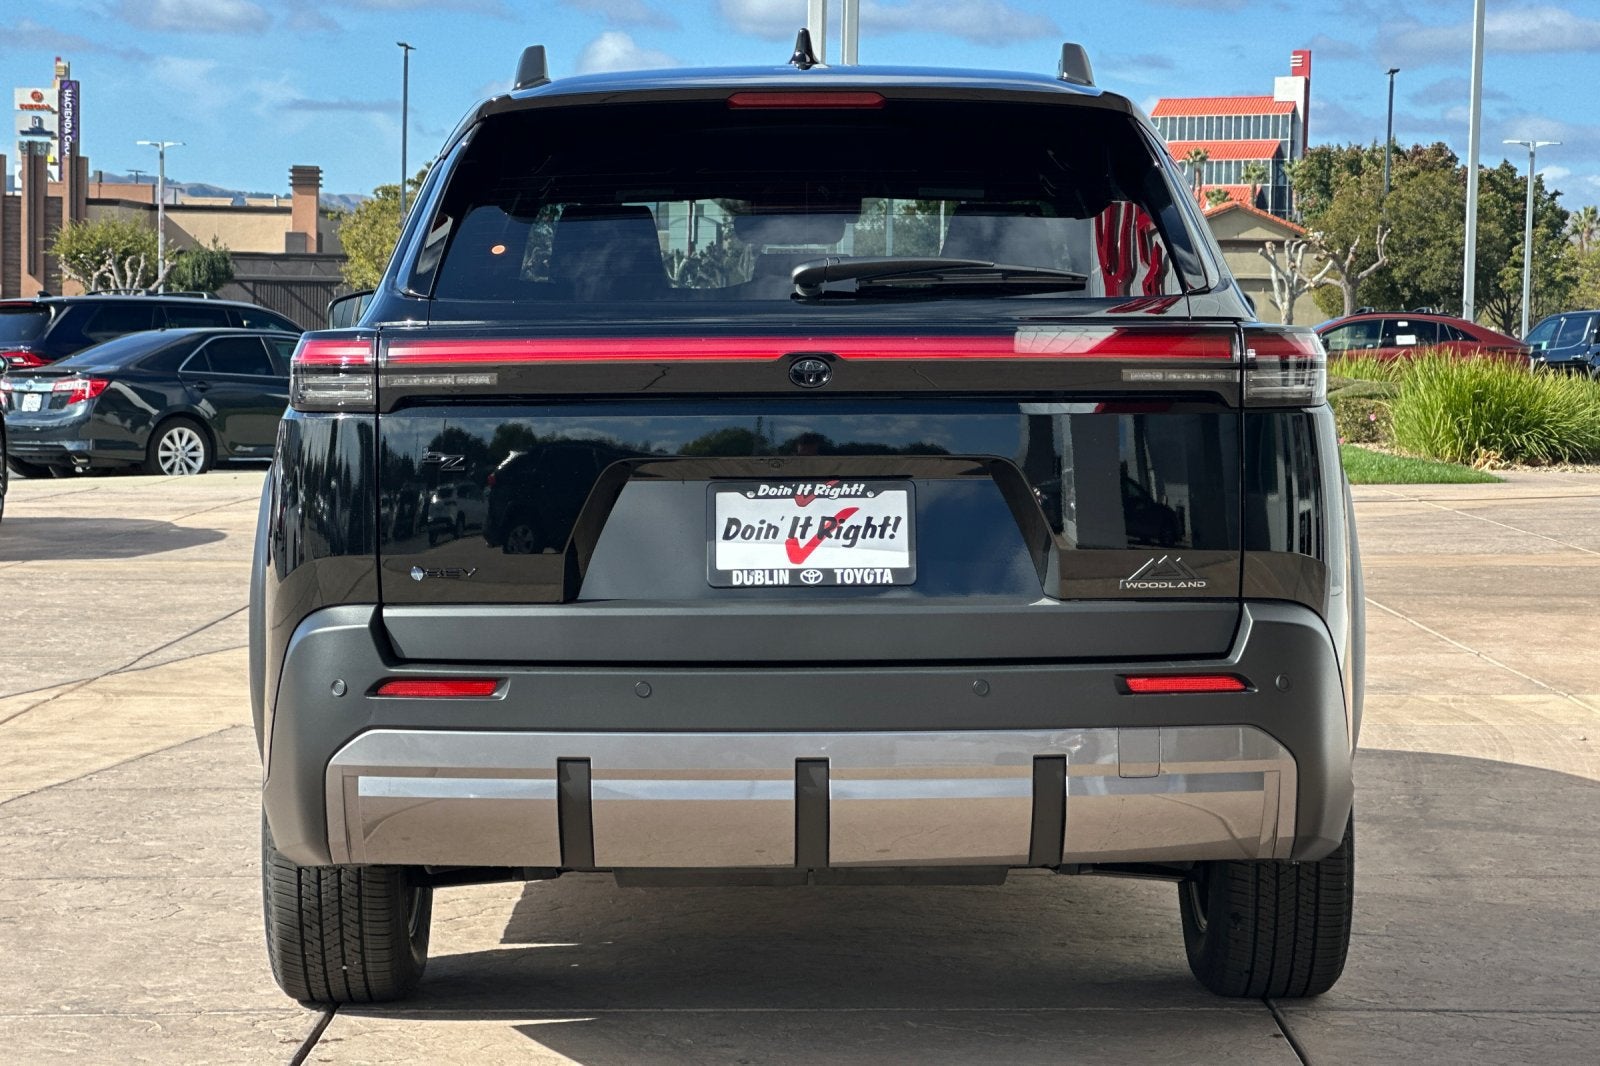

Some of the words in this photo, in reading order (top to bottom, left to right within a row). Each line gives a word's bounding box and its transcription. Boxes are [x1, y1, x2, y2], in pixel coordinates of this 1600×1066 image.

[64, 89, 72, 134] HACIENDA
[757, 484, 795, 496] Doin'
[796, 484, 812, 496] It
[814, 483, 866, 499] Right!
[722, 516, 785, 541] Doin'
[787, 516, 814, 540] It
[817, 515, 903, 548] Right!
[732, 570, 790, 586] DUBLIN
[834, 569, 894, 584] TOYOTA
[1125, 580, 1207, 589] WOODLAND
